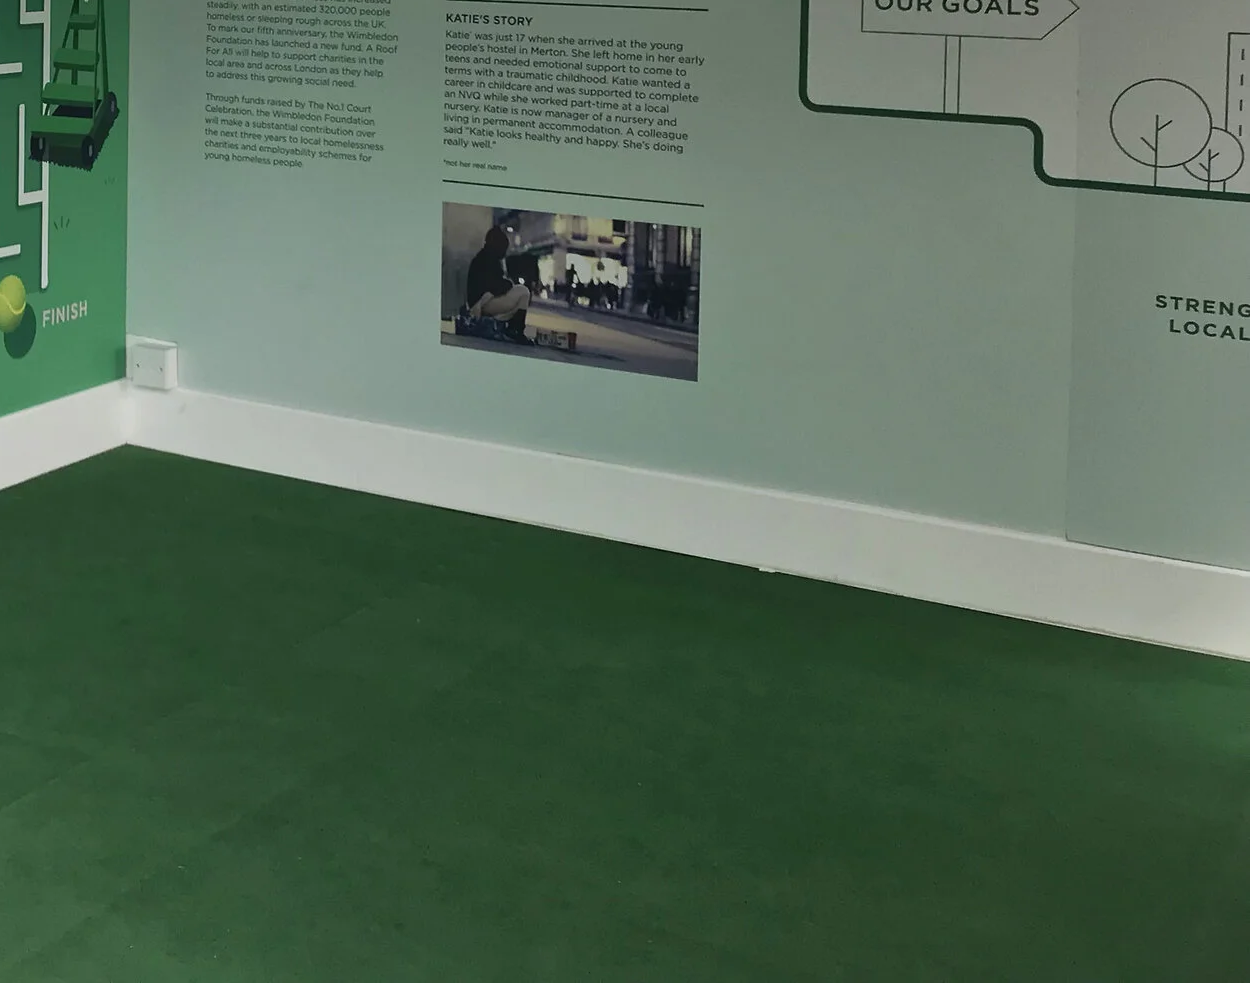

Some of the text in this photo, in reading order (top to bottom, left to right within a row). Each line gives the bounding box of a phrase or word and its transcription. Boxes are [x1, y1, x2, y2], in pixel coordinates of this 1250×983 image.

[446, 13, 533, 26] KATIE'S STORY
[495, 33, 513, 42] just
[516, 33, 525, 42] 17
[527, 34, 555, 43] when
[557, 35, 575, 45] she
[577, 38, 613, 47] arrived
[616, 39, 626, 48] at
[630, 39, 647, 49] the
[649, 41, 683, 52] young
[445, 43, 484, 52] people's
[487, 44, 516, 54] hostel
[518, 45, 527, 54] in
[530, 46, 568, 56] Merton.
[571, 48, 590, 58] She
[593, 49, 609, 59] left
[612, 50, 642, 61] home
[645, 52, 654, 62] in
[678, 55, 705, 66] early
[445, 54, 686, 76] teens and needed emotional support to come to
[444, 65, 471, 75] terms
[474, 67, 495, 76] with
[506, 70, 553, 81] traumatic
[612, 76, 638, 86] Katie
[641, 79, 681, 89] wanted
[444, 79, 474, 87] career
[487, 81, 532, 91] childcare
[534, 84, 553, 92] and
[578, 88, 631, 98] supported
[634, 90, 646, 99] to
[648, 92, 699, 103] complete
[444, 90, 455, 98] an
[458, 90, 480, 100] NVQ
[483, 92, 508, 102] while
[510, 94, 528, 103] she
[530, 96, 568, 106] worked
[570, 99, 619, 110] part-time
[621, 102, 631, 111] at
[644, 103, 669, 113] local
[443, 112, 688, 141] living in permanent accommodation. A colleague
[483, 104, 508, 113] Katie
[521, 108, 542, 116] now
[544, 110, 589, 121] manager
[591, 112, 602, 121] of
[614, 115, 654, 126] nursery
[656, 117, 677, 127] and
[204, 127, 384, 151] the next three years to local homelessness
[443, 126, 462, 134] said
[496, 129, 522, 139] looks
[524, 131, 561, 144] healthy
[563, 135, 583, 144] and
[622, 139, 650, 150] She's
[652, 141, 683, 154] doing
[443, 137, 469, 148] really
[204, 152, 230, 162] young
[231, 152, 271, 164] homeless
[42, 300, 88, 328] FINISH
[1155, 295, 1250, 318] STRENG
[1169, 319, 1250, 341] LOCAL
